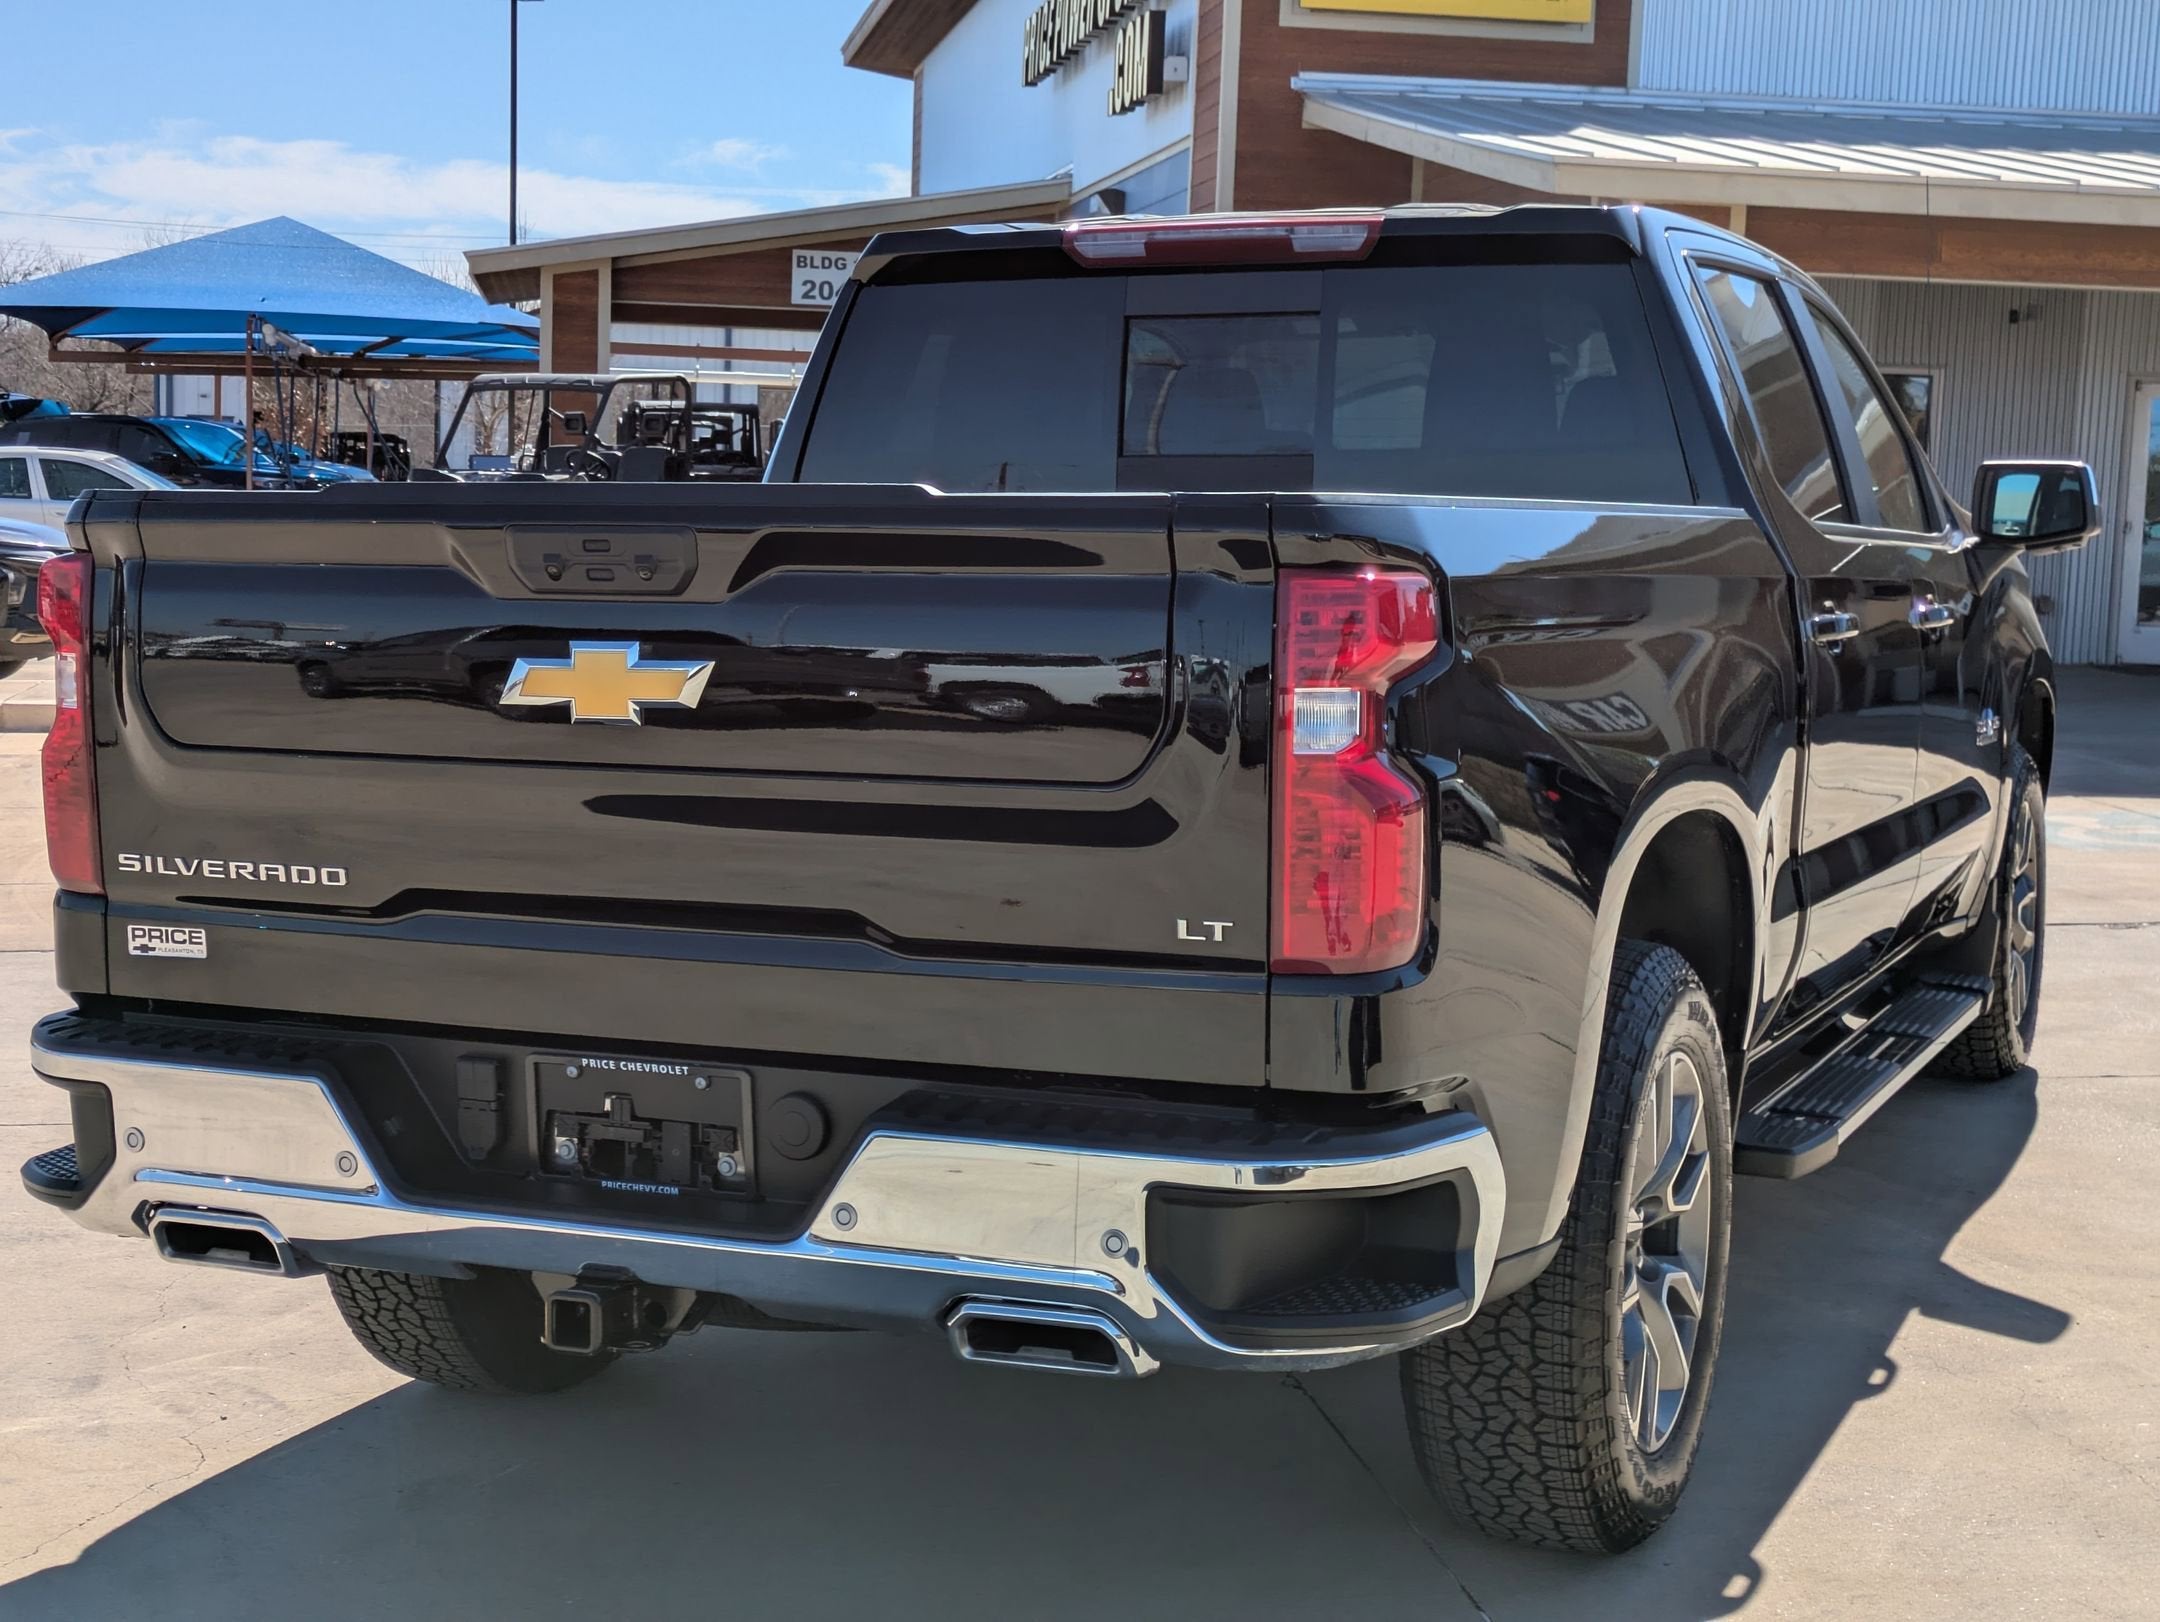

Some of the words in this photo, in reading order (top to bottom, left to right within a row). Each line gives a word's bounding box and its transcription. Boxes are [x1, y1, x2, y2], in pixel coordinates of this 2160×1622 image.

[796, 255, 847, 271] BLDG
[801, 279, 843, 301] 20
[118, 853, 348, 886] SILVERADO
[131, 927, 204, 946] PRICE
[1177, 918, 1234, 942] LT
[581, 1057, 616, 1071] PRICE
[619, 1060, 690, 1076] CHEVROLET
[601, 1180, 680, 1196] PRICECHEVY.COM
